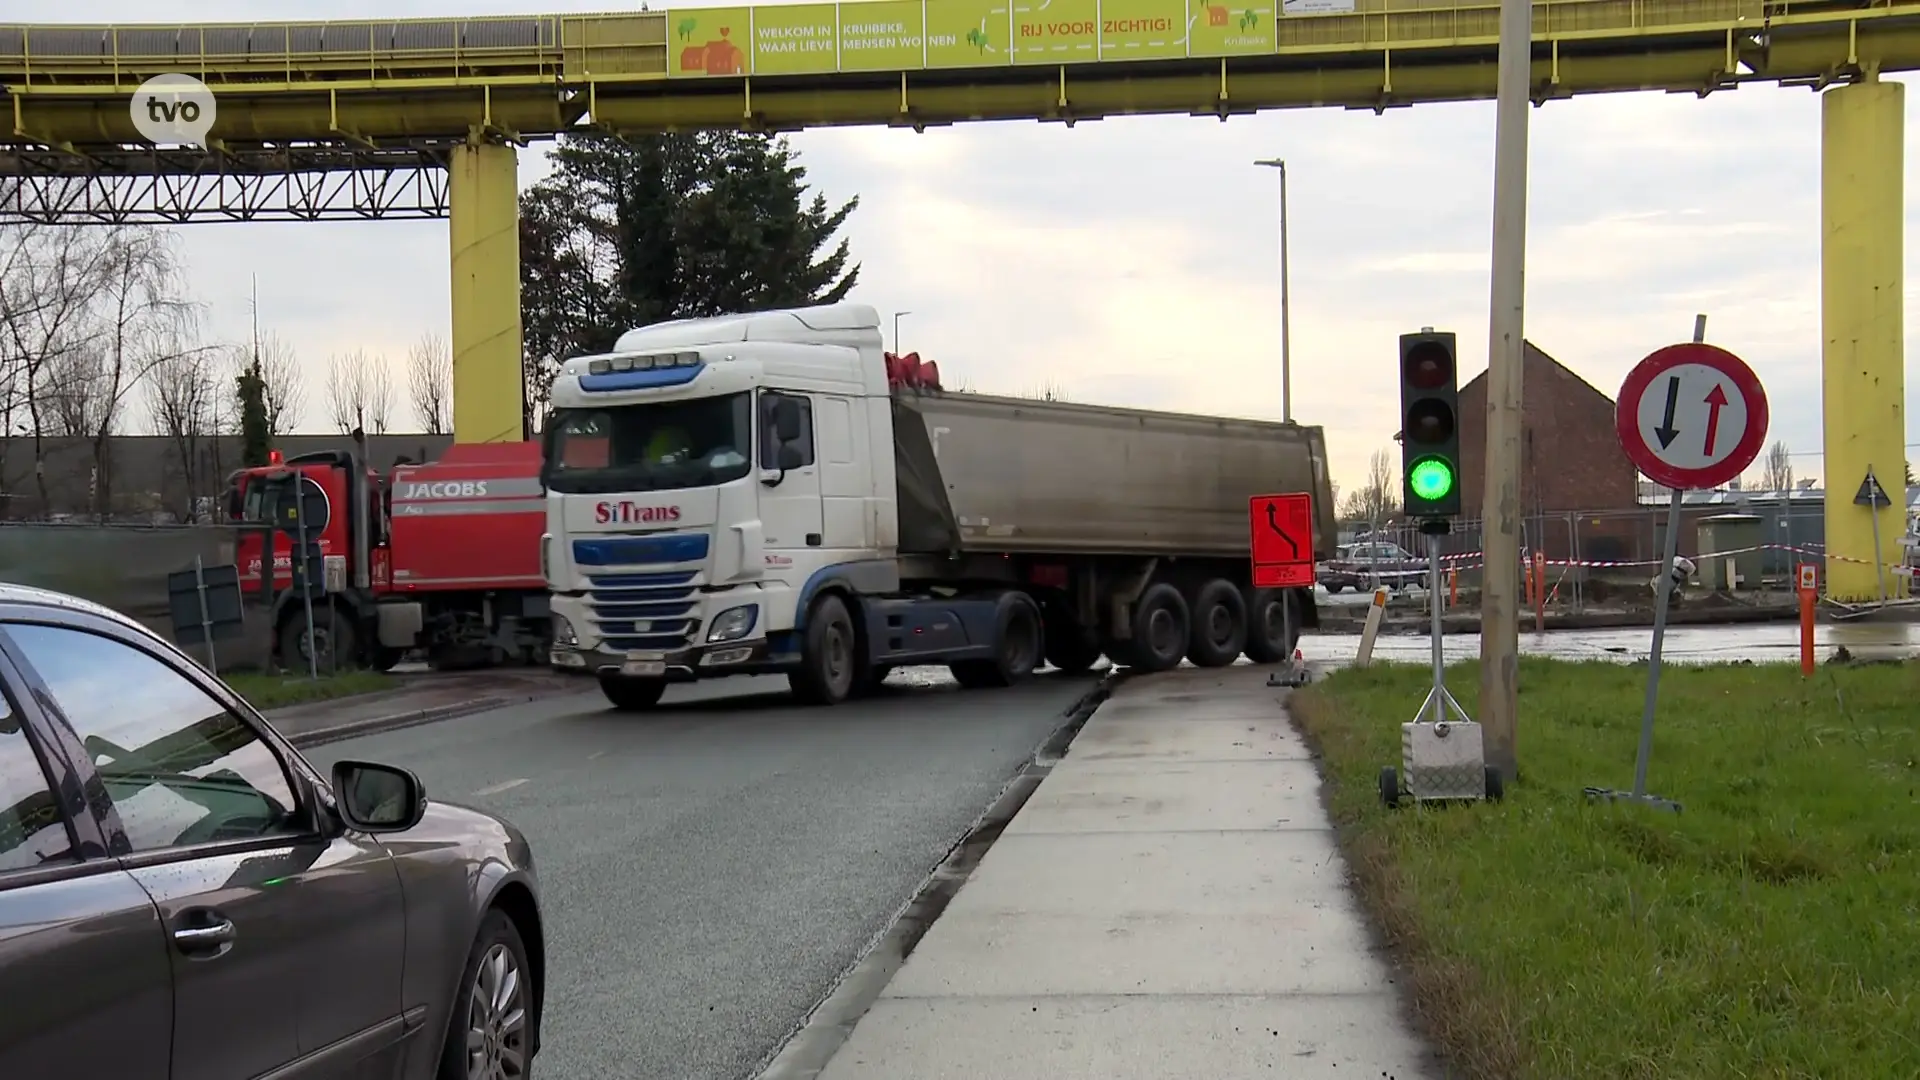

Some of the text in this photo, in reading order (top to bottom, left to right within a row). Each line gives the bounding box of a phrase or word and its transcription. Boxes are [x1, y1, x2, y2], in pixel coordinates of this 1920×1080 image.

[759, 23, 906, 38] WELKOM IN KRUIBEKE,
[1021, 24, 1042, 37] RIJ
[759, 41, 796, 52] WAAR
[800, 40, 833, 51] LIEVE
[843, 38, 895, 50] MENSEN
[404, 481, 488, 498] JACOBS
[596, 501, 681, 524] SiTrans
